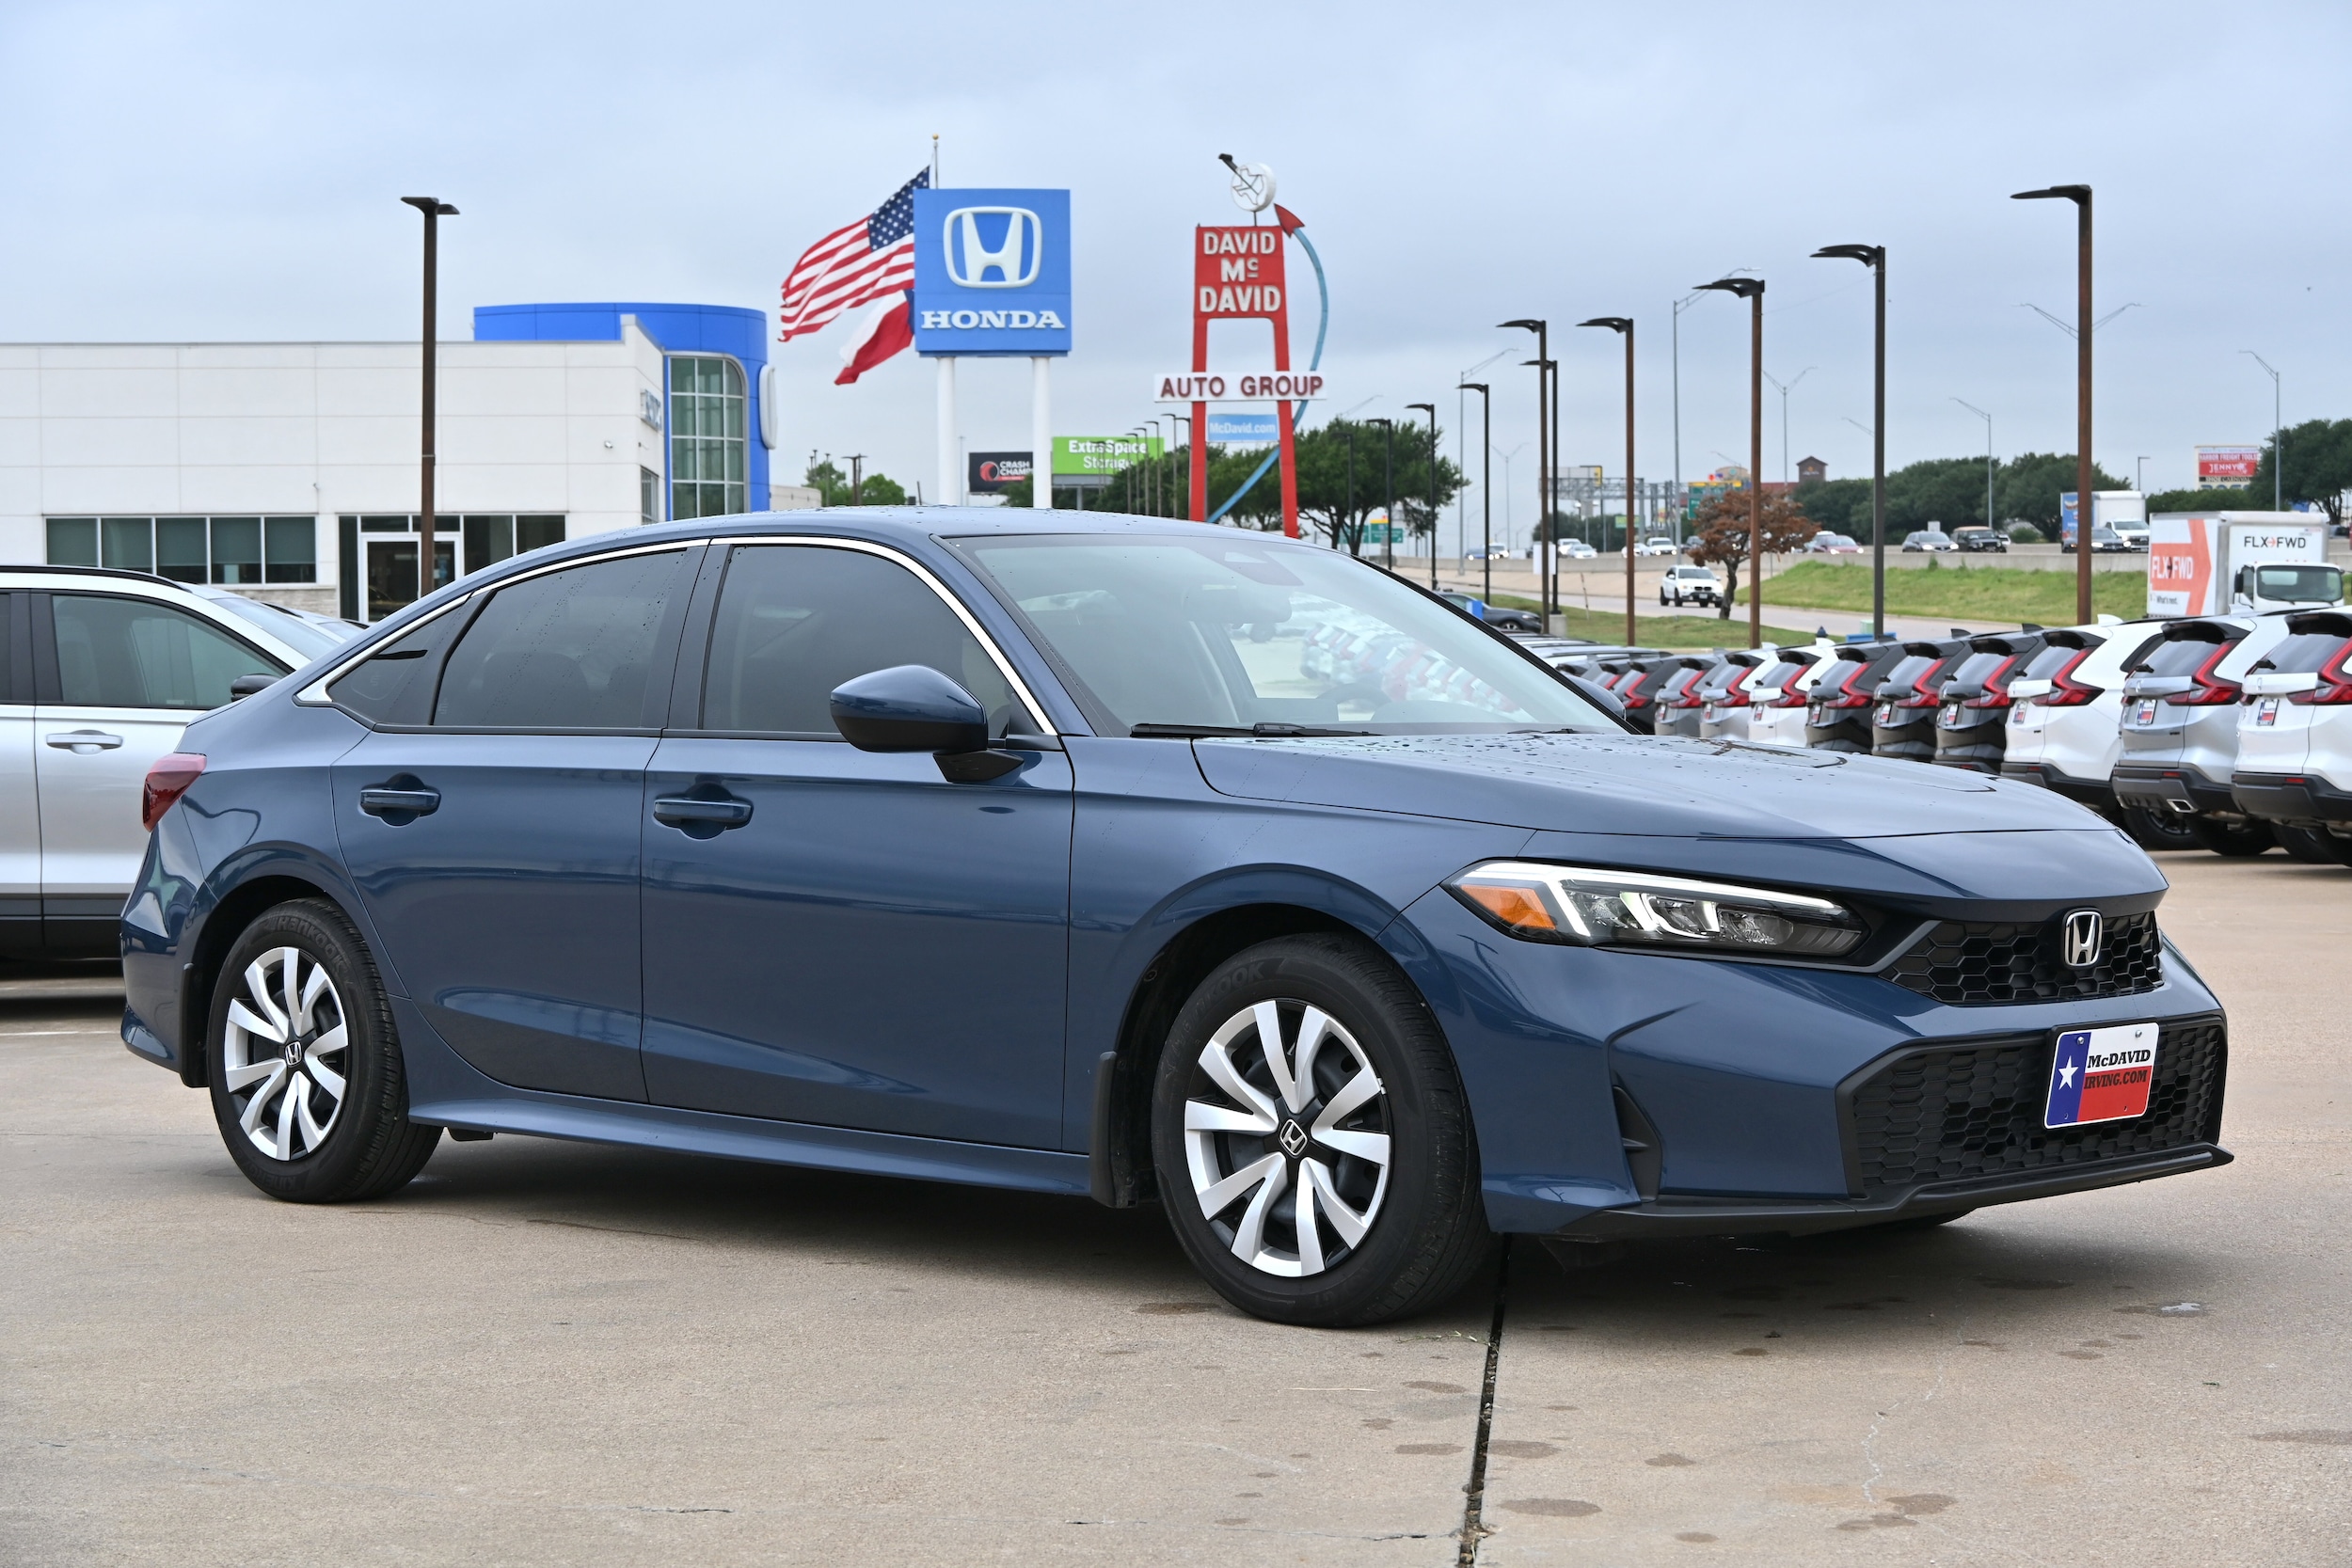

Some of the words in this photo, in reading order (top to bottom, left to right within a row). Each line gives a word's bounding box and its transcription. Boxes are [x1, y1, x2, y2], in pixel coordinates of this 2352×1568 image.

[1203, 231, 1276, 255] DAVID
[1220, 257, 1259, 282] Mc
[1200, 285, 1281, 312] DAVID
[920, 309, 1066, 329] HONDA
[1160, 375, 1226, 398] AUTO
[1240, 375, 1323, 397] GROUP
[1209, 422, 1276, 435] McDavid.com
[999, 460, 1030, 468] CRASH
[2087, 1049, 2152, 1069] McDAVID
[2083, 1069, 2148, 1090] IRVING.COM
